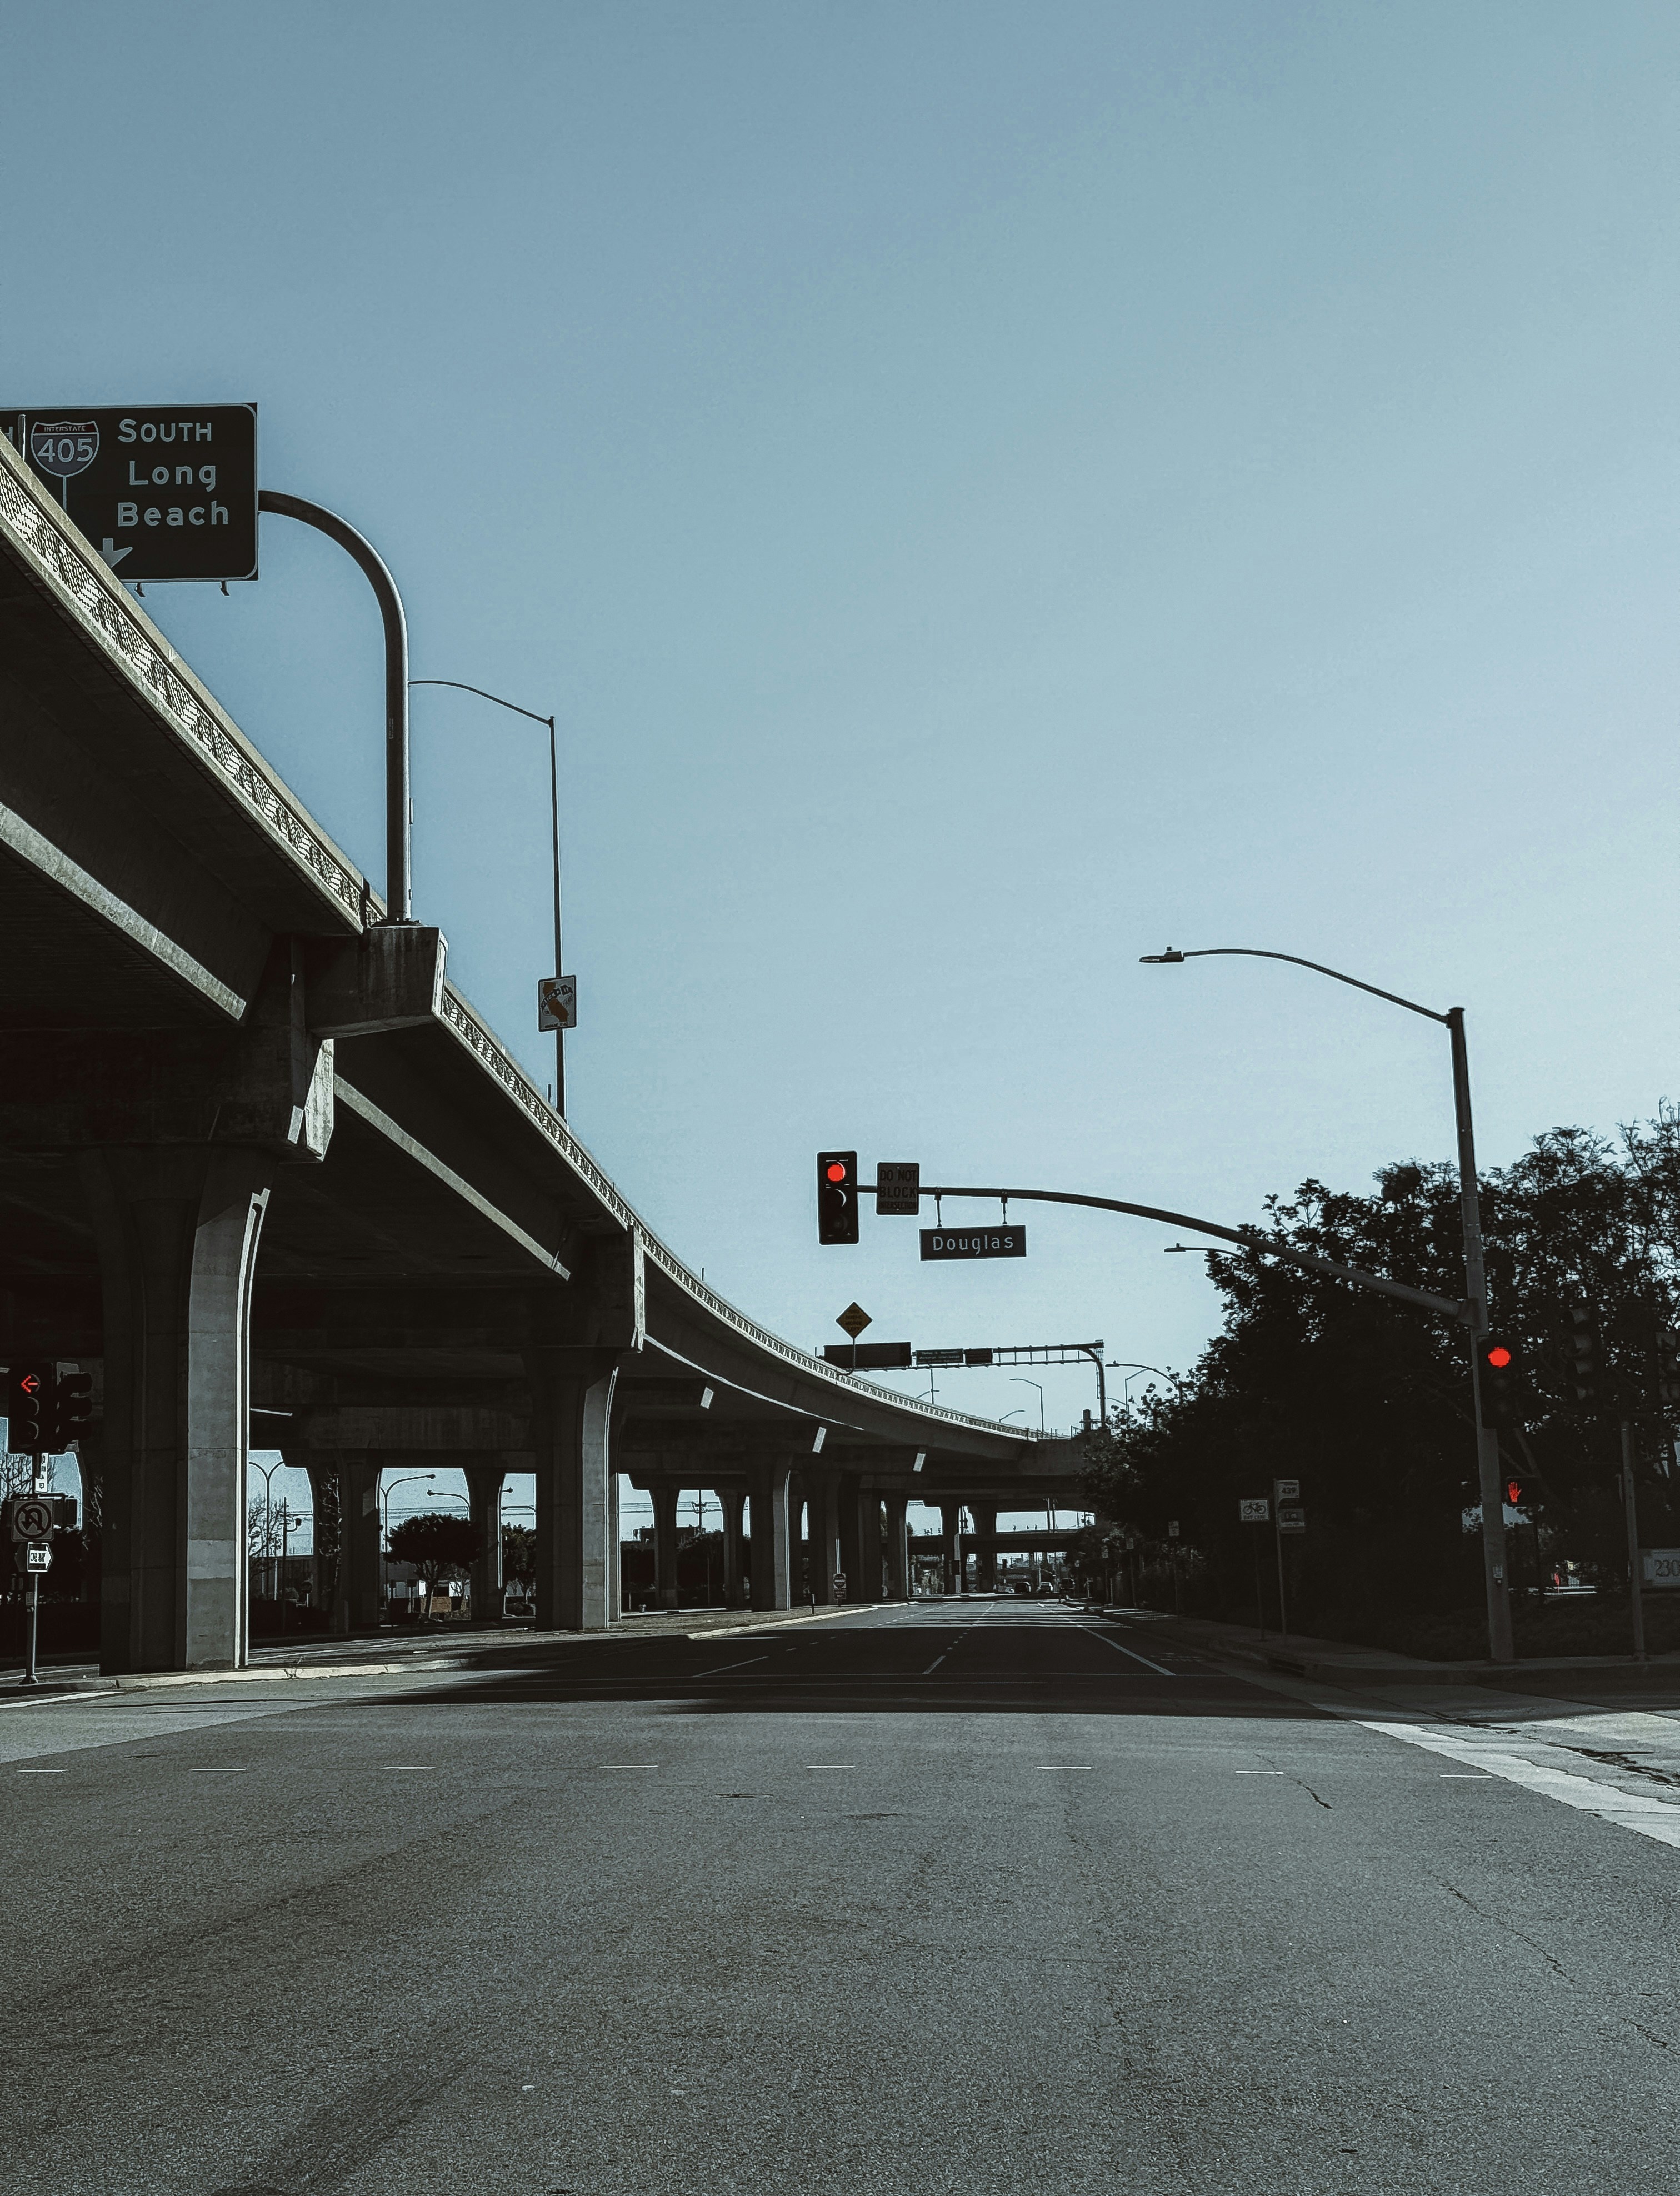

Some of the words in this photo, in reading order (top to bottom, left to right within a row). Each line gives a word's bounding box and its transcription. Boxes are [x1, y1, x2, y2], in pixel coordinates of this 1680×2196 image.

[118, 419, 212, 443] SOUTH
[37, 438, 93, 463] 405
[129, 461, 216, 492] Long
[118, 501, 228, 527] Beach
[879, 1169, 893, 1182] DO
[898, 1170, 917, 1182] NOT
[879, 1186, 916, 1198] BLOCK
[933, 1235, 1014, 1255] Douglas
